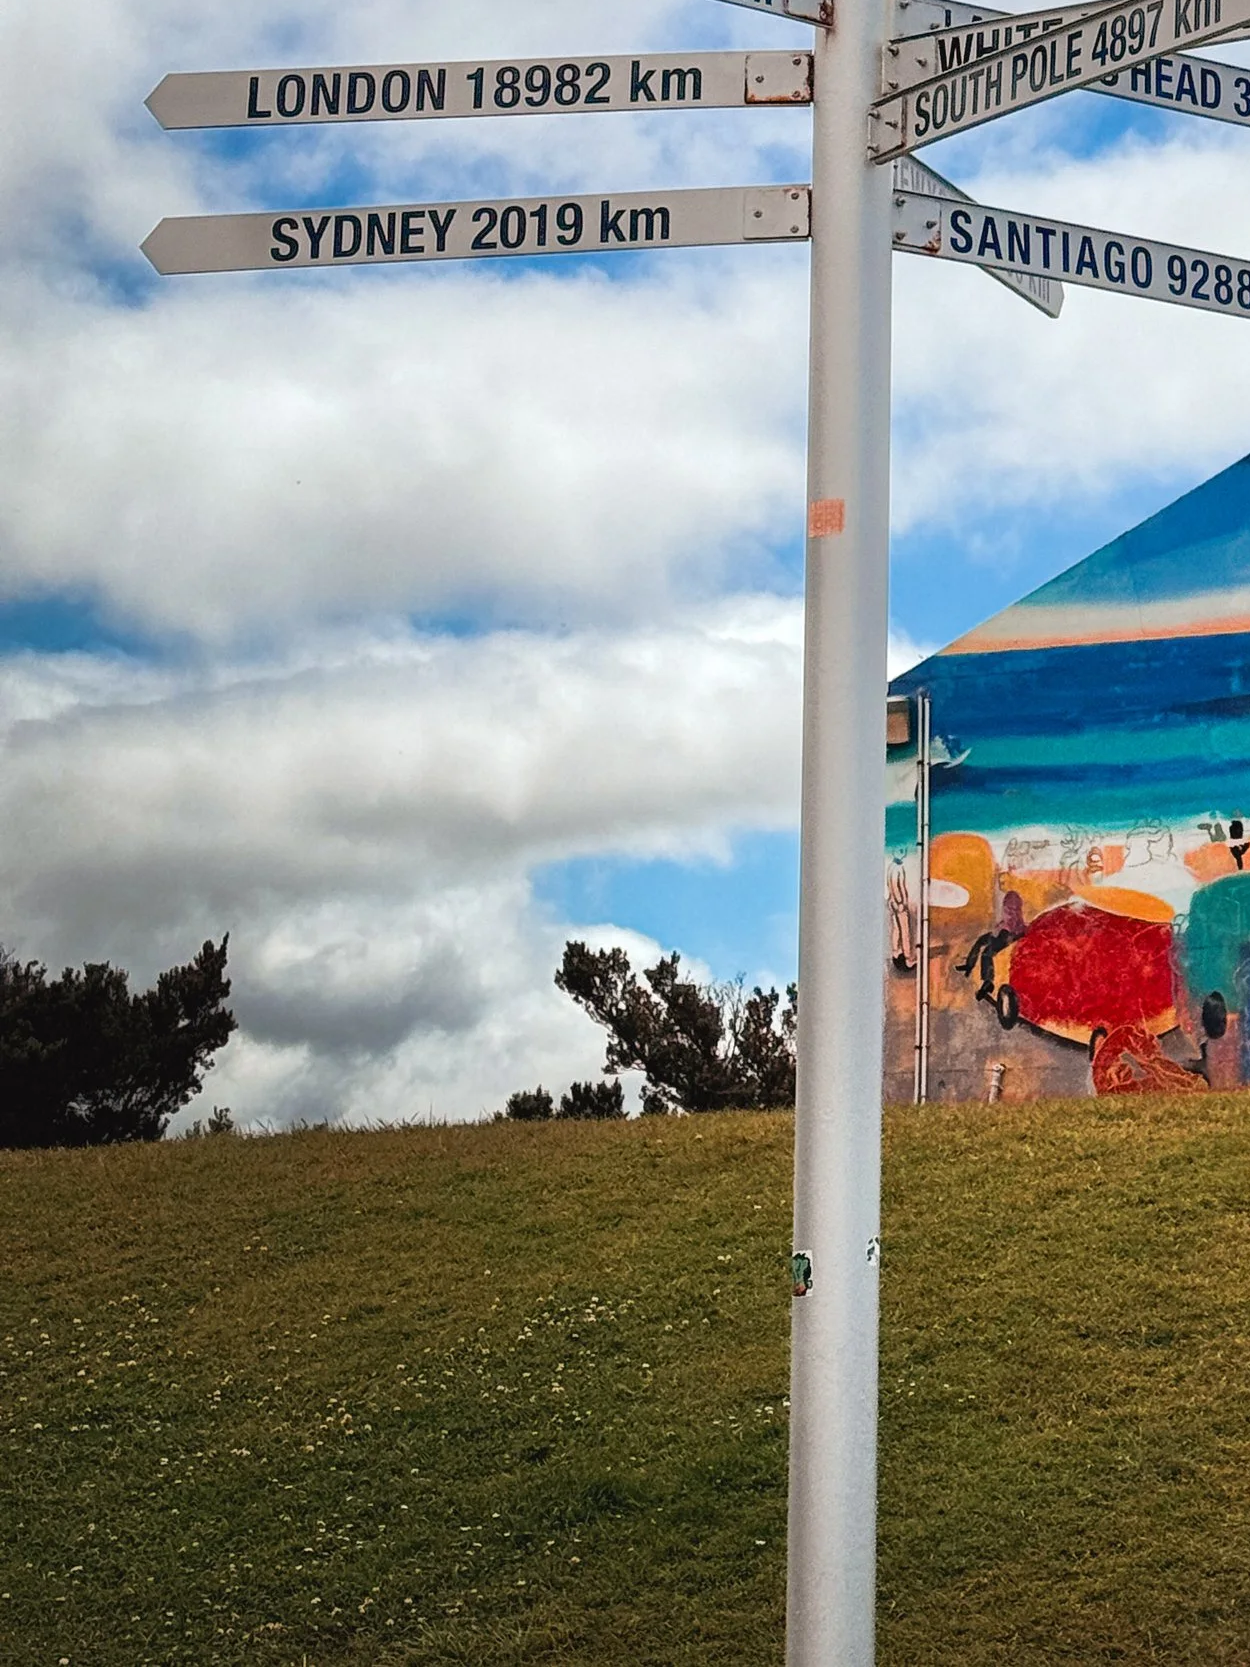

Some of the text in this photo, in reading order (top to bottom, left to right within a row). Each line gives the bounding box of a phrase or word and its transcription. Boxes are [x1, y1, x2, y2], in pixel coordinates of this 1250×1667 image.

[915, 61, 1003, 136] SOUTH
[1011, 30, 1083, 100] POLE
[1092, 0, 1164, 66] 4897
[938, 17, 1063, 72] WHIT
[247, 59, 702, 119] LONDON 18982 km
[1131, 58, 1221, 109] HEAD
[270, 199, 670, 263] SYDNEY 2019 km
[950, 208, 1152, 289] SANTIAGO
